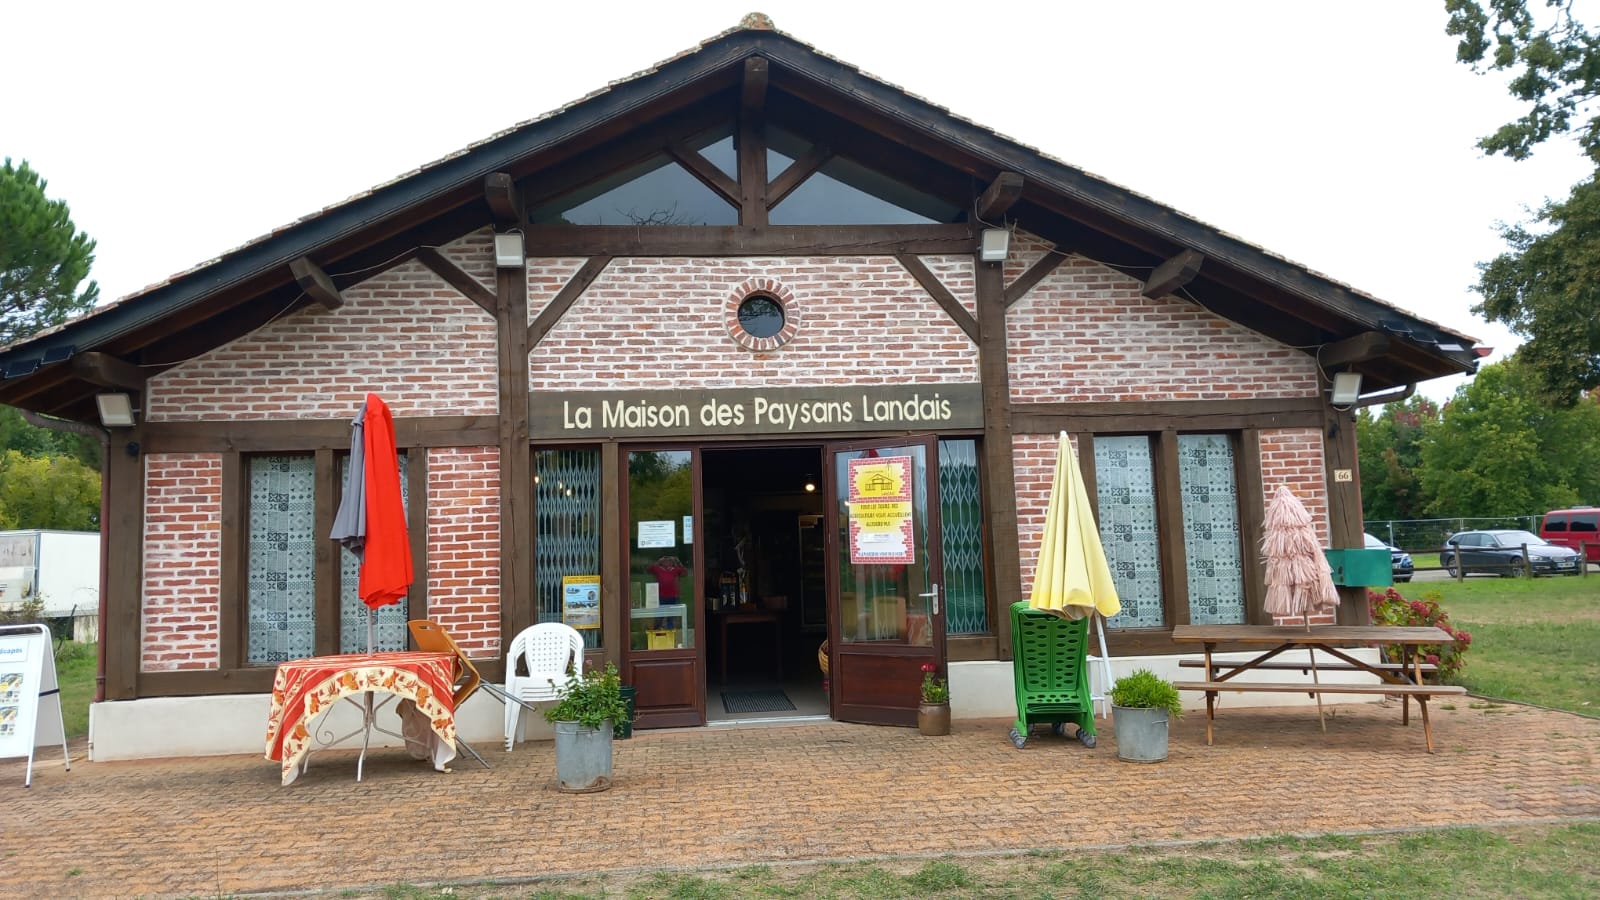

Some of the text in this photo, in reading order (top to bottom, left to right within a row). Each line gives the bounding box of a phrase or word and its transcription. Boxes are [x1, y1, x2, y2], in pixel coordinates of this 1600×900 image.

[563, 393, 952, 431] La Maison des Paysans Landais
[1338, 471, 1349, 480] 66
